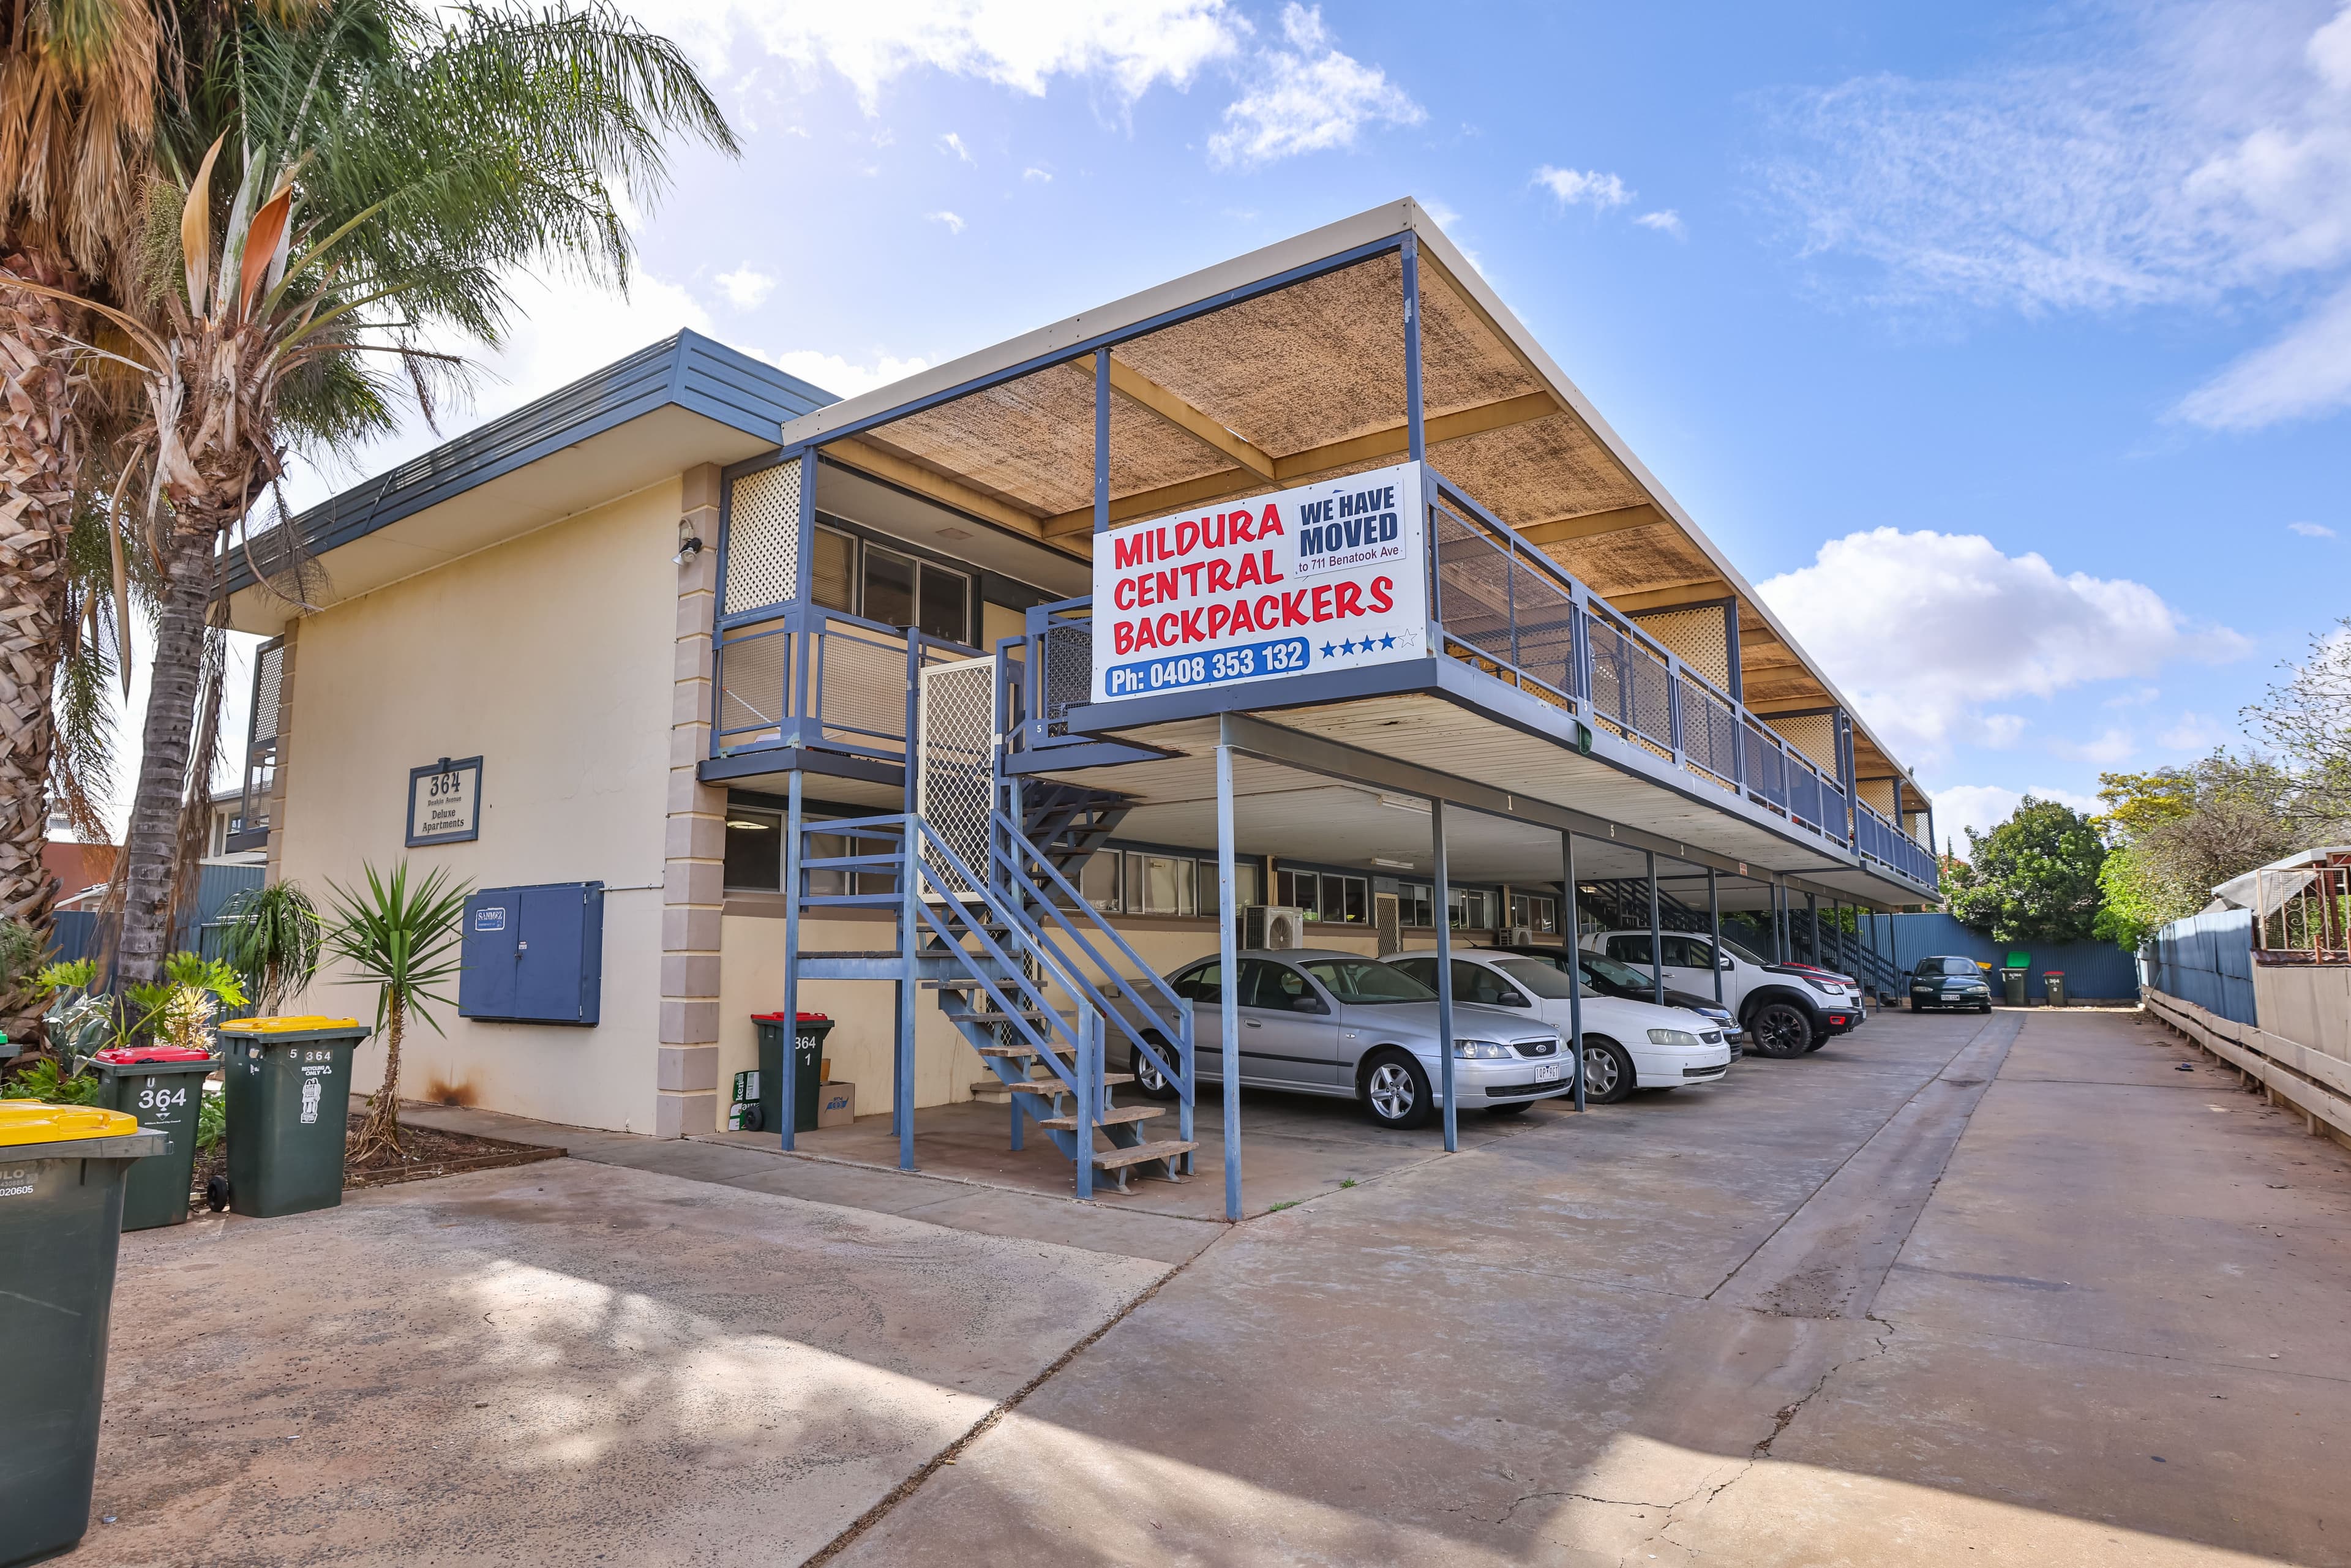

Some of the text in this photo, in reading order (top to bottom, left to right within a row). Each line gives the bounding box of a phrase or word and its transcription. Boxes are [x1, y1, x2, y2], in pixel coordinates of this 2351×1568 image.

[1300, 486, 1395, 526] WE HAVE
[1114, 503, 1284, 569] MILDURA
[1300, 512, 1398, 557] MOVED
[1299, 546, 1399, 572] to 711 Benatook Ave
[1114, 549, 1284, 610] CENTRAL
[1114, 576, 1393, 655] BACKPACKERS
[1112, 642, 1303, 693] Ph: 0408 353 132
[1037, 724, 1041, 733] 5
[430, 772, 460, 796] 364
[1507, 795, 1513, 811] 1
[432, 809, 456, 819] Deluxe
[422, 818, 464, 833] Apartments
[1610, 824, 1614, 838] 5
[1681, 845, 1684, 856] 2
[795, 1036, 816, 1049] 364
[290, 1049, 331, 1061] 5 364
[805, 1053, 811, 1065] 1
[148, 1078, 156, 1088] U
[138, 1088, 186, 1109] 364
